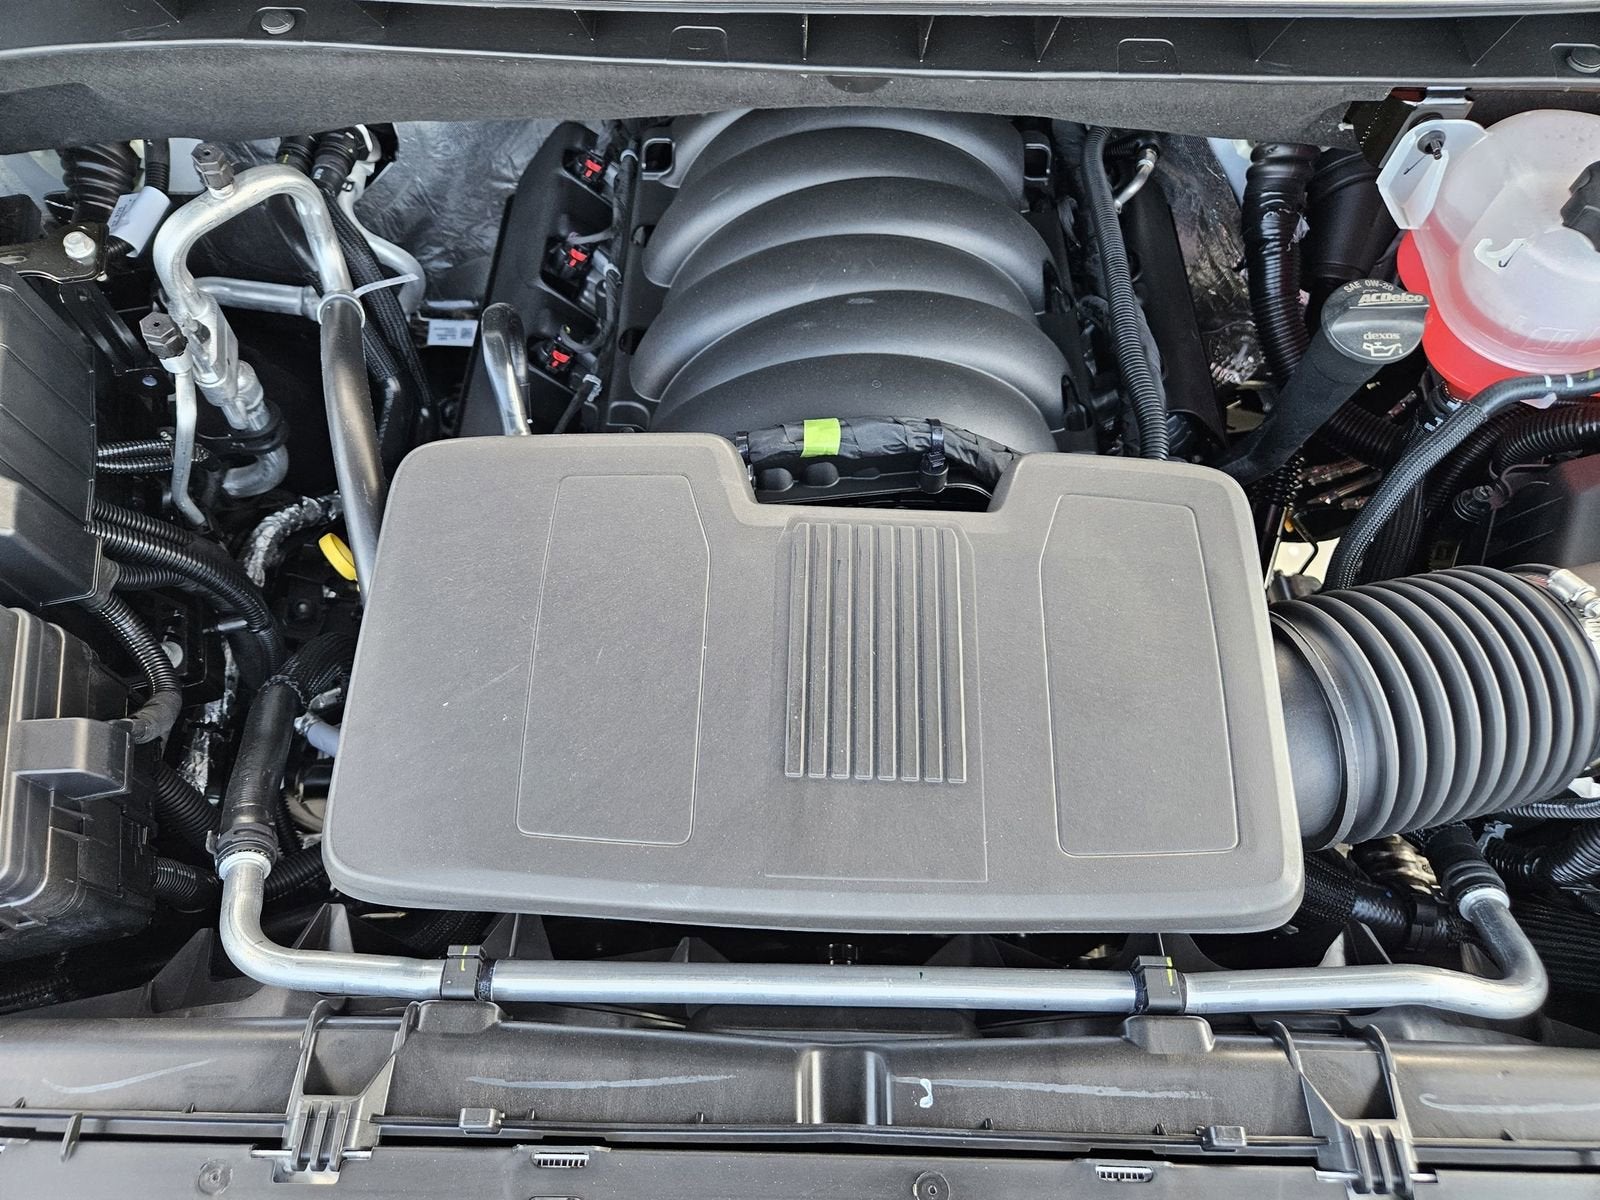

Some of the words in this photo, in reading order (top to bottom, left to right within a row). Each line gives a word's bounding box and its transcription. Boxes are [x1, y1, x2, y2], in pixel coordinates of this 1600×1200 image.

[1343, 281, 1361, 293] SAE
[1364, 280, 1394, 291] 0W-20
[1358, 292, 1424, 305] ACDelco
[1363, 331, 1400, 340] dexos
